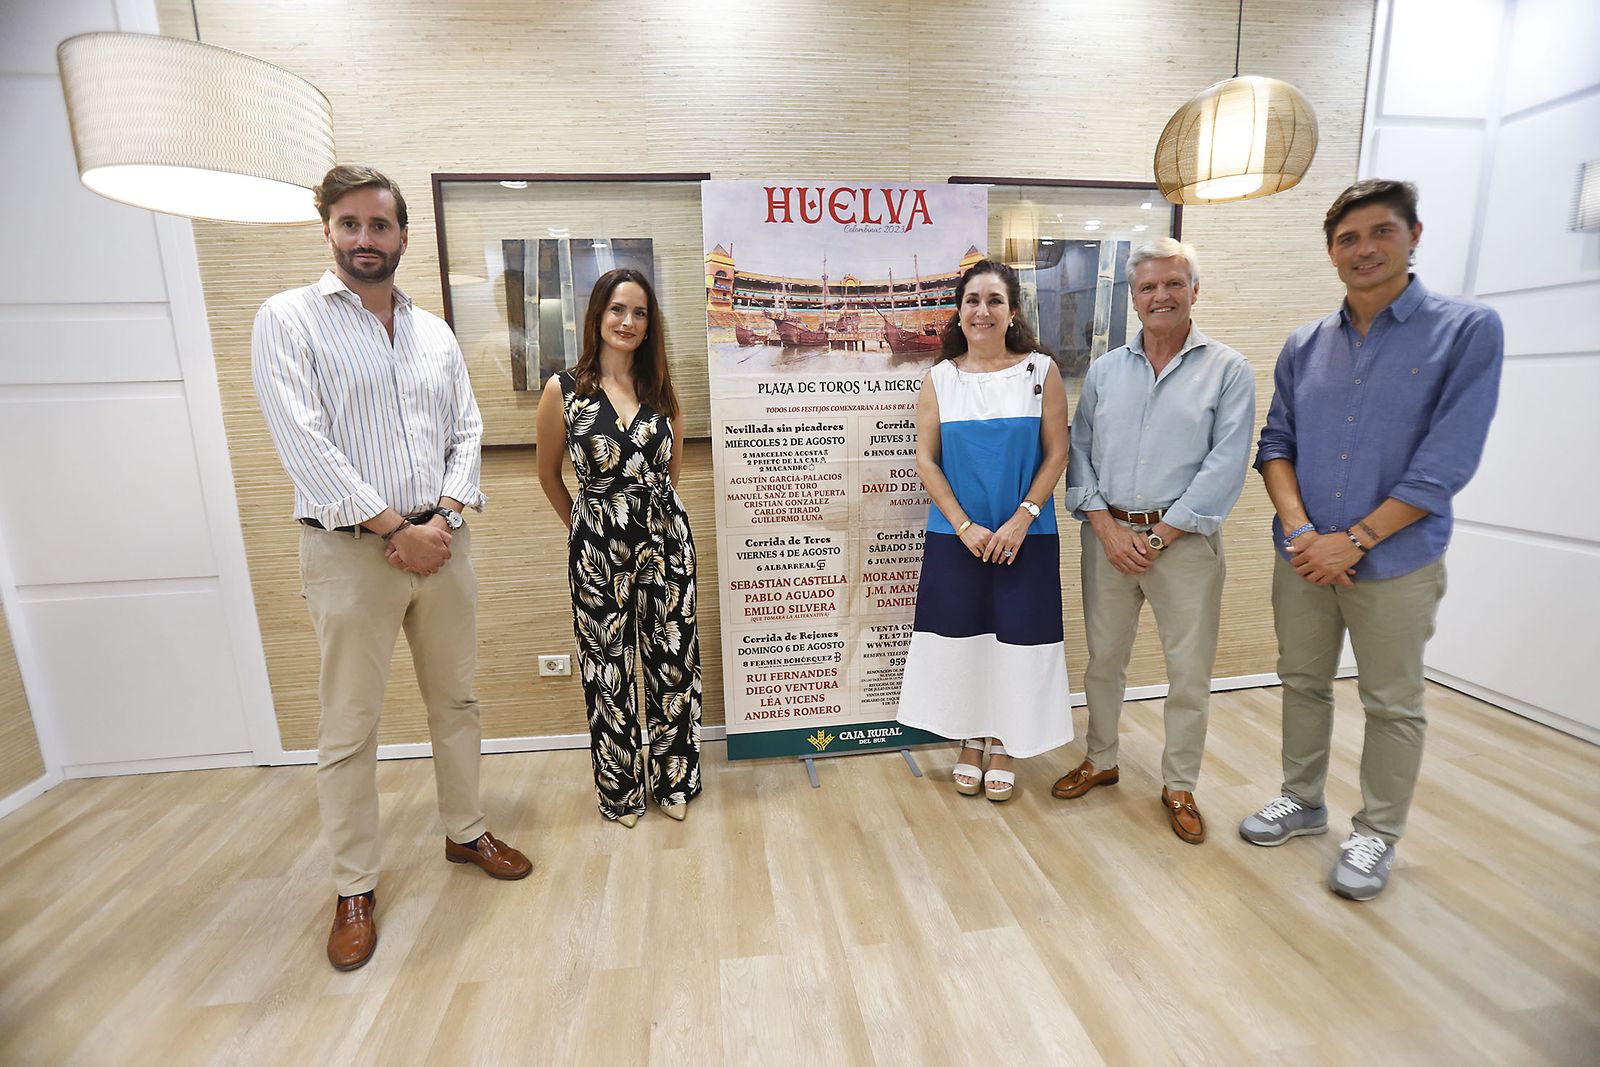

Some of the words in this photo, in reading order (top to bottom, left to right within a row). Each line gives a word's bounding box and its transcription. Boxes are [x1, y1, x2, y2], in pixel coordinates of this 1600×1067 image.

[763, 186, 933, 233] HUELVA
[883, 225, 906, 234] 2023
[758, 382, 794, 395] PLAZA
[798, 382, 816, 392] DE
[820, 380, 860, 394] TOROS
[885, 380, 923, 392] MERC
[725, 424, 774, 434] Novillada
[776, 424, 792, 433] sin
[795, 422, 844, 433] picadores
[876, 420, 915, 429] Corrida
[725, 438, 780, 448] MIÉRCOLES
[782, 438, 788, 446] 2
[805, 436, 846, 445] AGOSTO
[870, 435, 903, 446] JUEVES
[905, 434, 911, 442] 3
[730, 475, 767, 484] AGUSTÍN
[770, 473, 842, 483] GARCÍA-PALACIOS
[756, 484, 792, 492] ENRIQUE
[862, 483, 898, 493] DAVID
[901, 483, 916, 491] DE
[727, 492, 762, 501] MANUEL
[744, 500, 782, 508] CRISTIAN
[785, 497, 830, 506] GONZÁLEZ
[752, 516, 799, 524] GUILLERMO
[877, 530, 915, 540] Corrida
[745, 537, 786, 548] Corrida
[788, 536, 800, 545] de
[804, 536, 831, 544] Toros
[869, 543, 906, 553] SÁBADO
[736, 550, 777, 560] VIERNES
[787, 549, 800, 557] DE
[802, 547, 840, 556] AGOSTO
[764, 562, 816, 571] ALBARREAL
[863, 570, 918, 582] MORANTE
[730, 577, 790, 590] SEBASTIÁN
[793, 575, 847, 586] CASTELLA
[745, 592, 782, 603] PABLO
[786, 589, 835, 600] AGUADO
[866, 586, 886, 598] J.M.
[744, 606, 785, 616] EMILIO
[789, 602, 836, 614] SILVERA
[743, 634, 782, 643] Corrida
[785, 632, 797, 641] de
[800, 631, 838, 640] Rejones
[738, 645, 783, 656] DOMINGO
[807, 641, 844, 650] AGOSTO
[750, 658, 782, 666] FERMÍN
[890, 658, 906, 666] 959
[746, 674, 767, 682] RUI
[770, 668, 838, 680] FERNANDES
[746, 685, 782, 696] DIEGO
[785, 680, 839, 692] VENTURA
[760, 696, 781, 707] LÉA
[785, 694, 825, 705] VICENS
[745, 708, 790, 720] ANDRÉS
[794, 705, 841, 716] ROMERO
[839, 730, 865, 740] CAJA
[867, 727, 902, 738] RURAL
